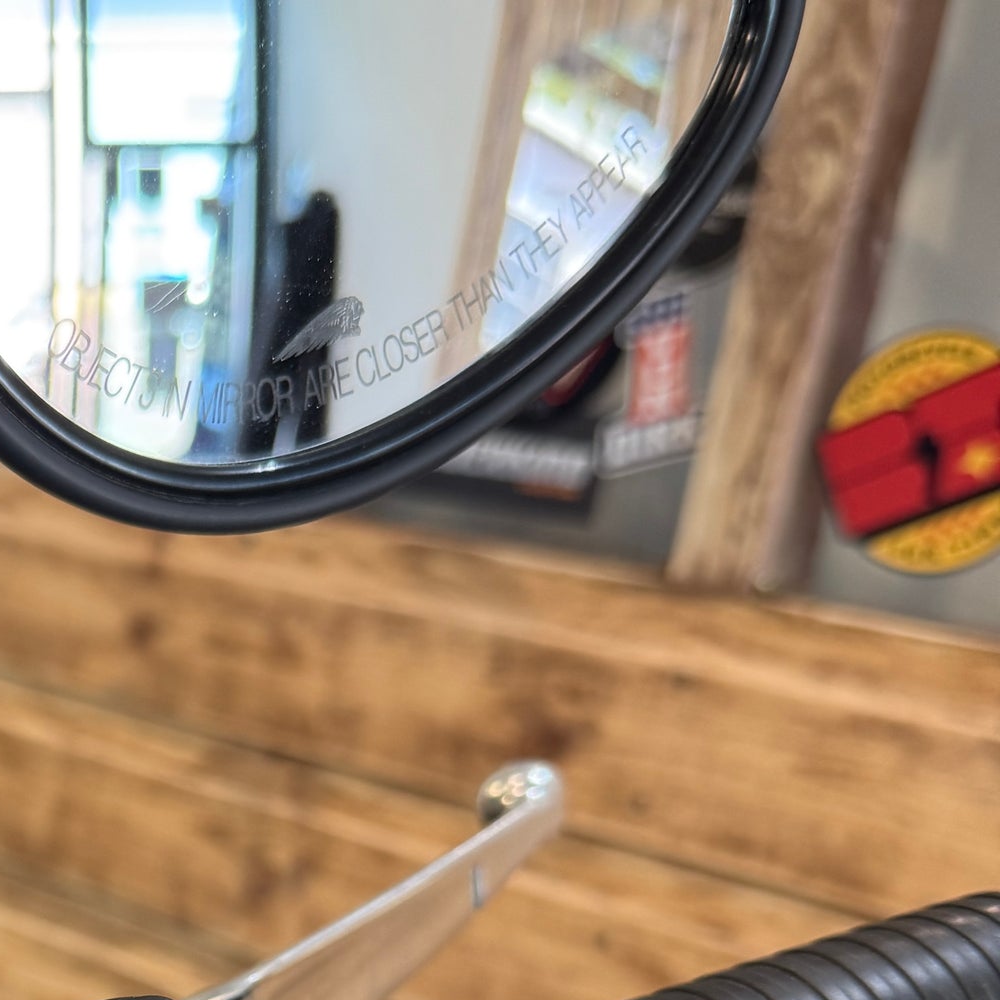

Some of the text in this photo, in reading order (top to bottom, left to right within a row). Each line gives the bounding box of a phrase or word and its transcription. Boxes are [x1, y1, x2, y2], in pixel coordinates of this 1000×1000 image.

[47, 125, 648, 425] OBJECTS IN MIRROR ARE CLOSER THAN THEY APPEAR
